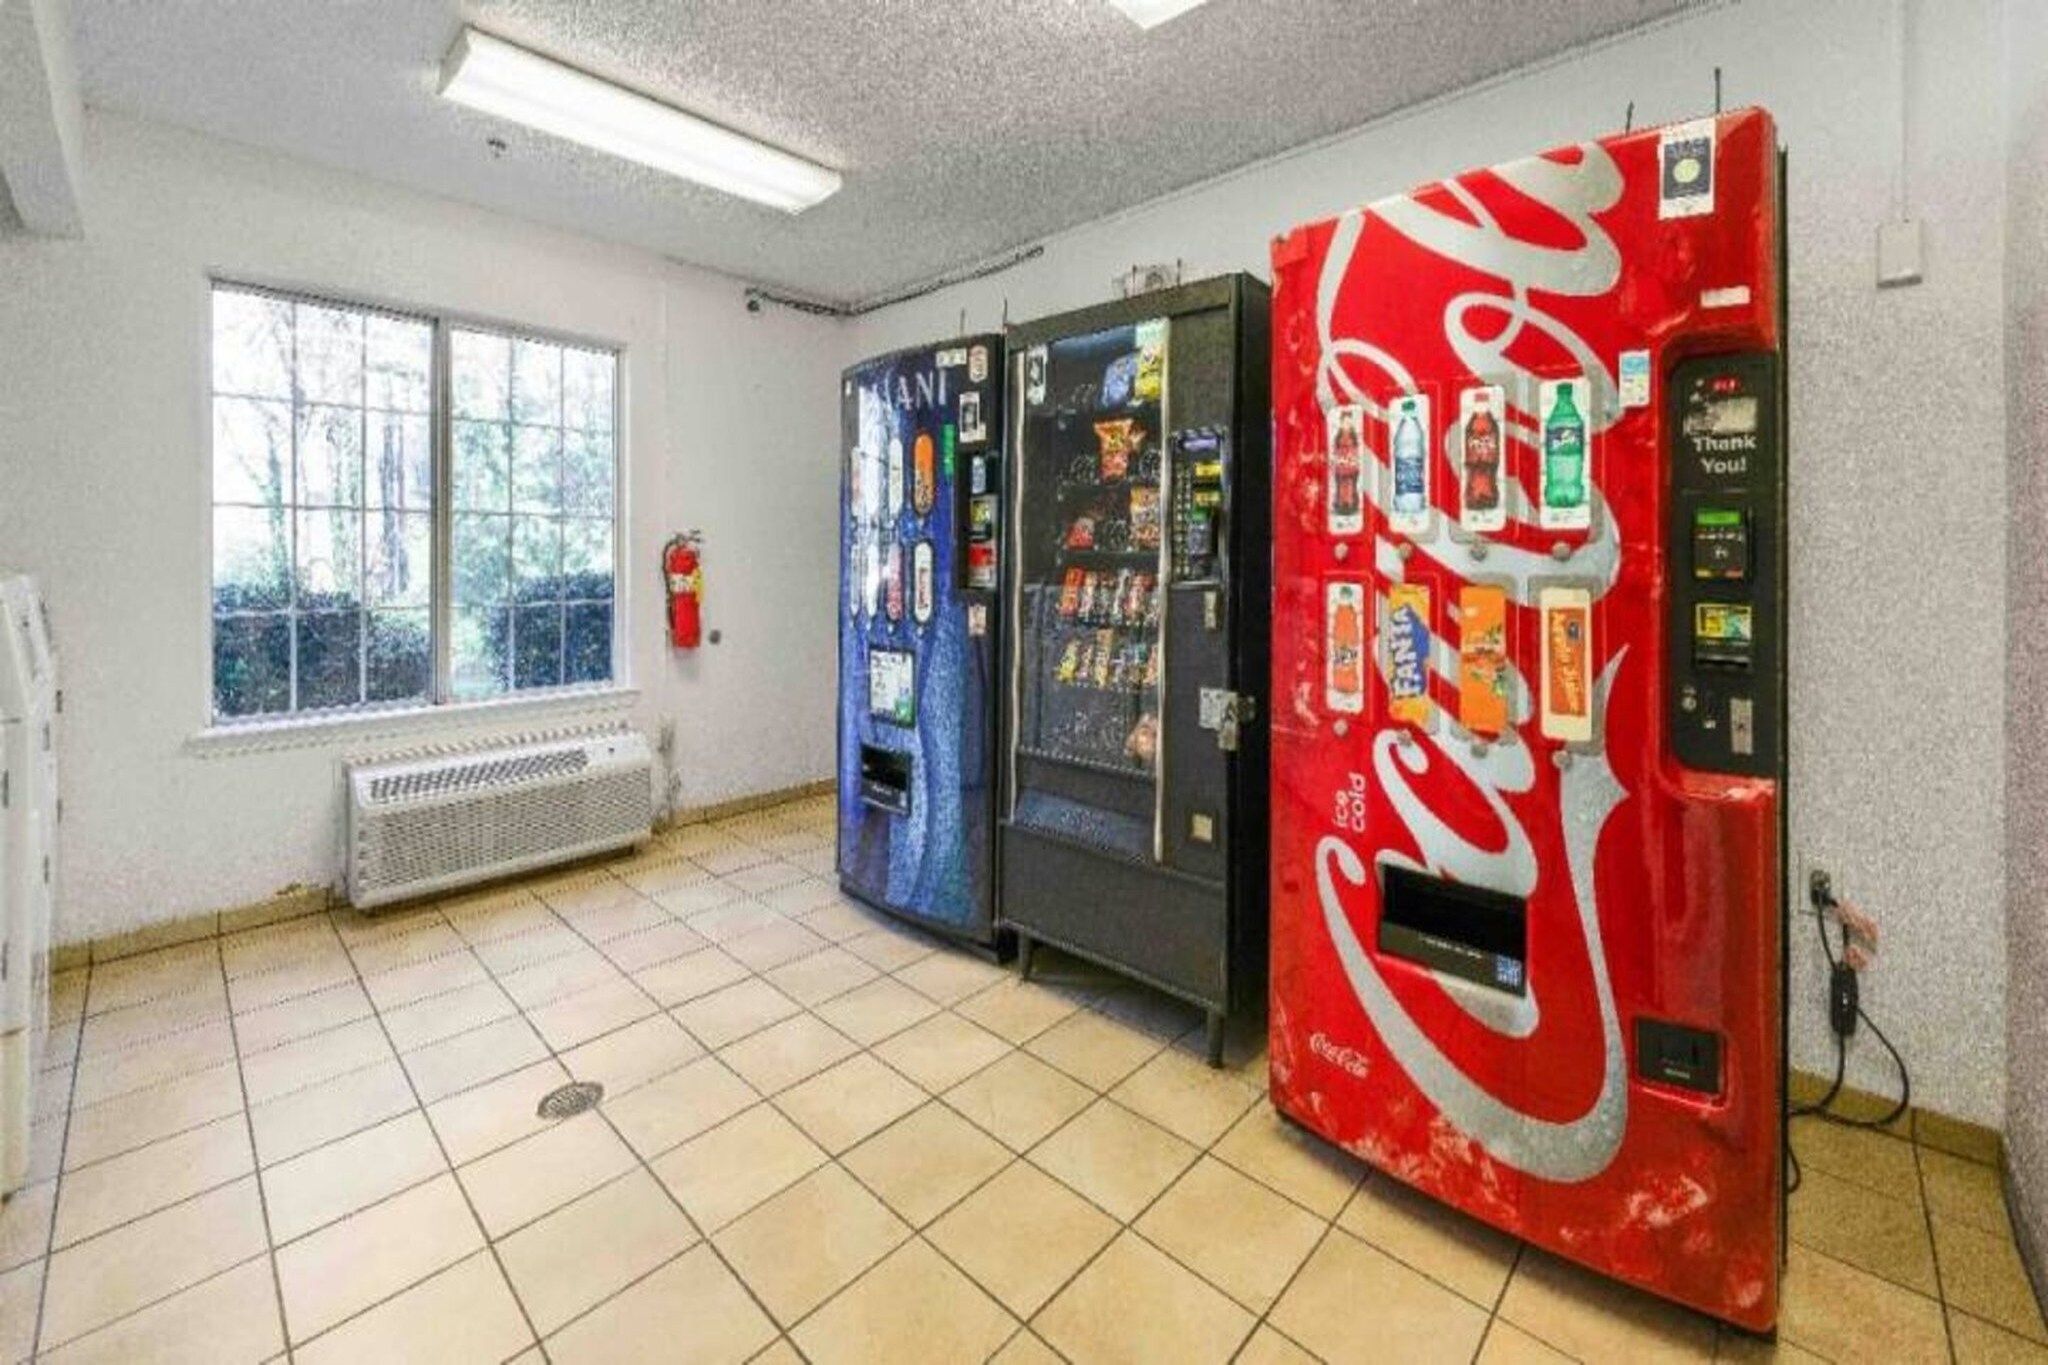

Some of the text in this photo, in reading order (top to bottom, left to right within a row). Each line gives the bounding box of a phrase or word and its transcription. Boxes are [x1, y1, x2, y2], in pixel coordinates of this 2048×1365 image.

[1692, 434, 1757, 453] Thank
[1700, 457, 1747, 474] You!
[1331, 789, 1349, 828] ice
[1348, 771, 1366, 833] cold
